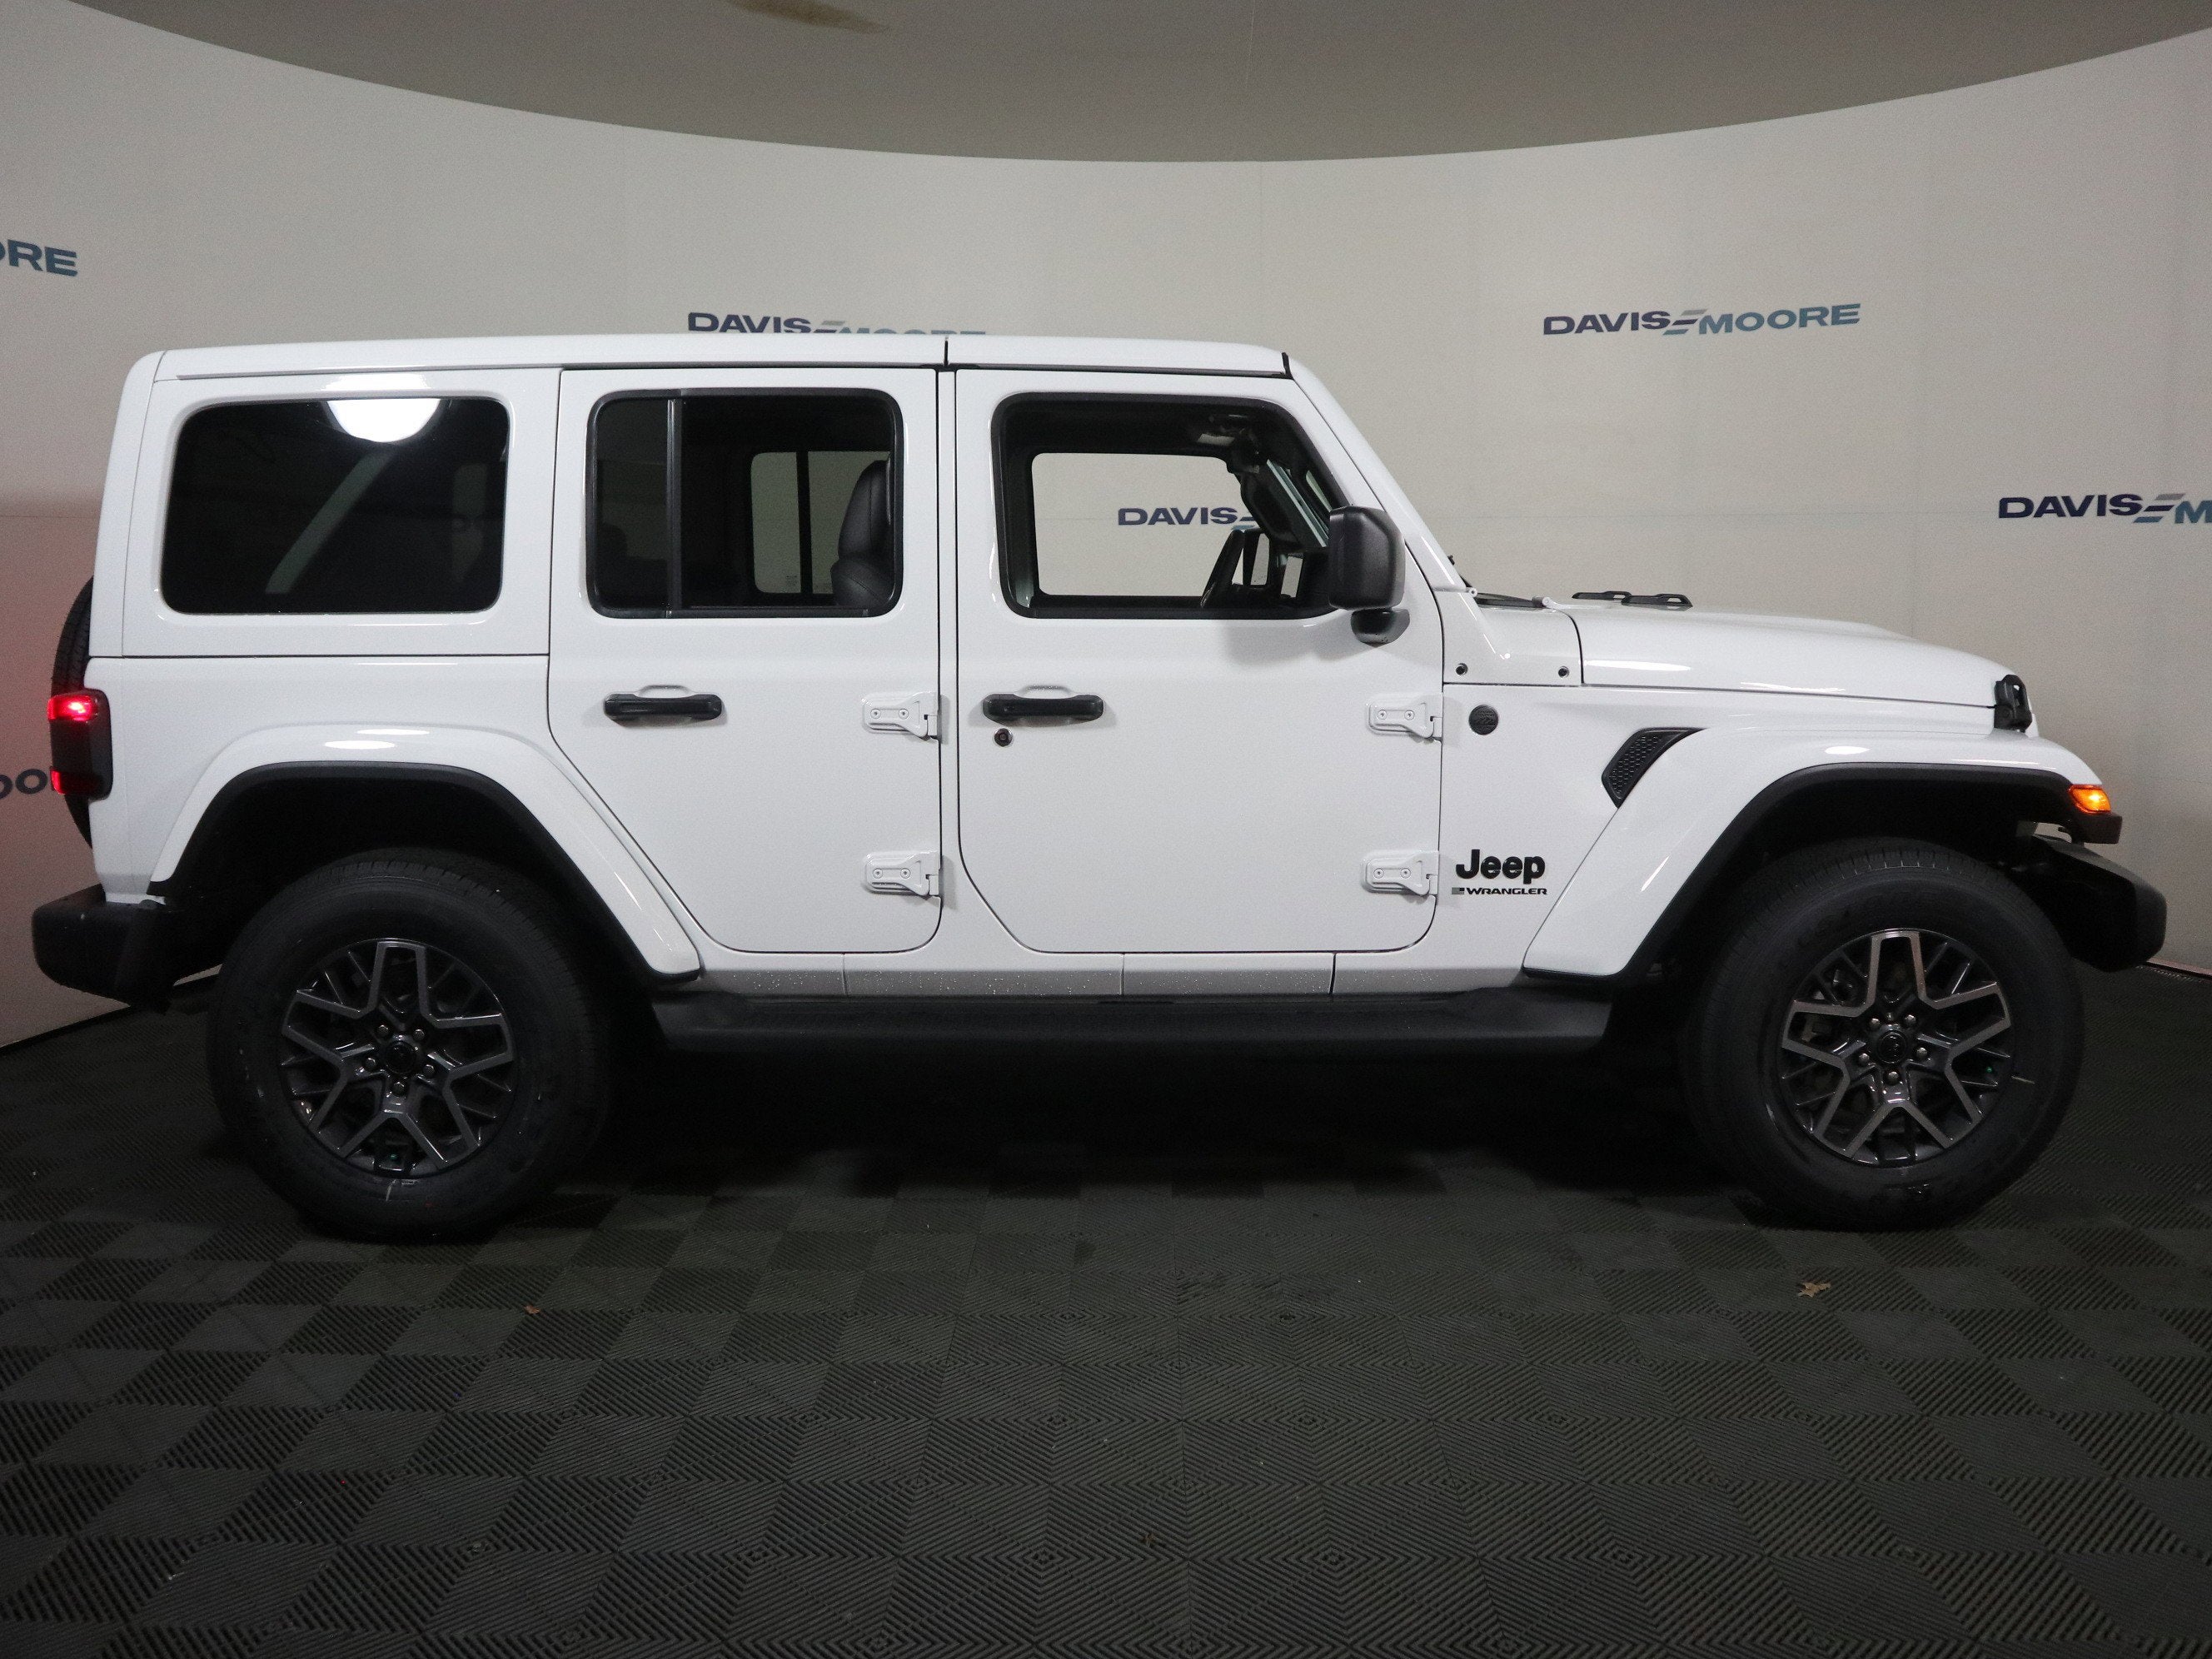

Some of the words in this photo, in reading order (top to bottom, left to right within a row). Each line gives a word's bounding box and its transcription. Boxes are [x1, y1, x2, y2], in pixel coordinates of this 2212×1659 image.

[0, 239, 78, 276] RE
[688, 312, 811, 333] DAVIS
[1543, 311, 1671, 335] DAVIS
[1698, 303, 1861, 335] MOORE
[1118, 507, 1238, 526] DAVIS
[1999, 494, 2144, 518] DAVIS
[1456, 849, 1546, 884] Jeep
